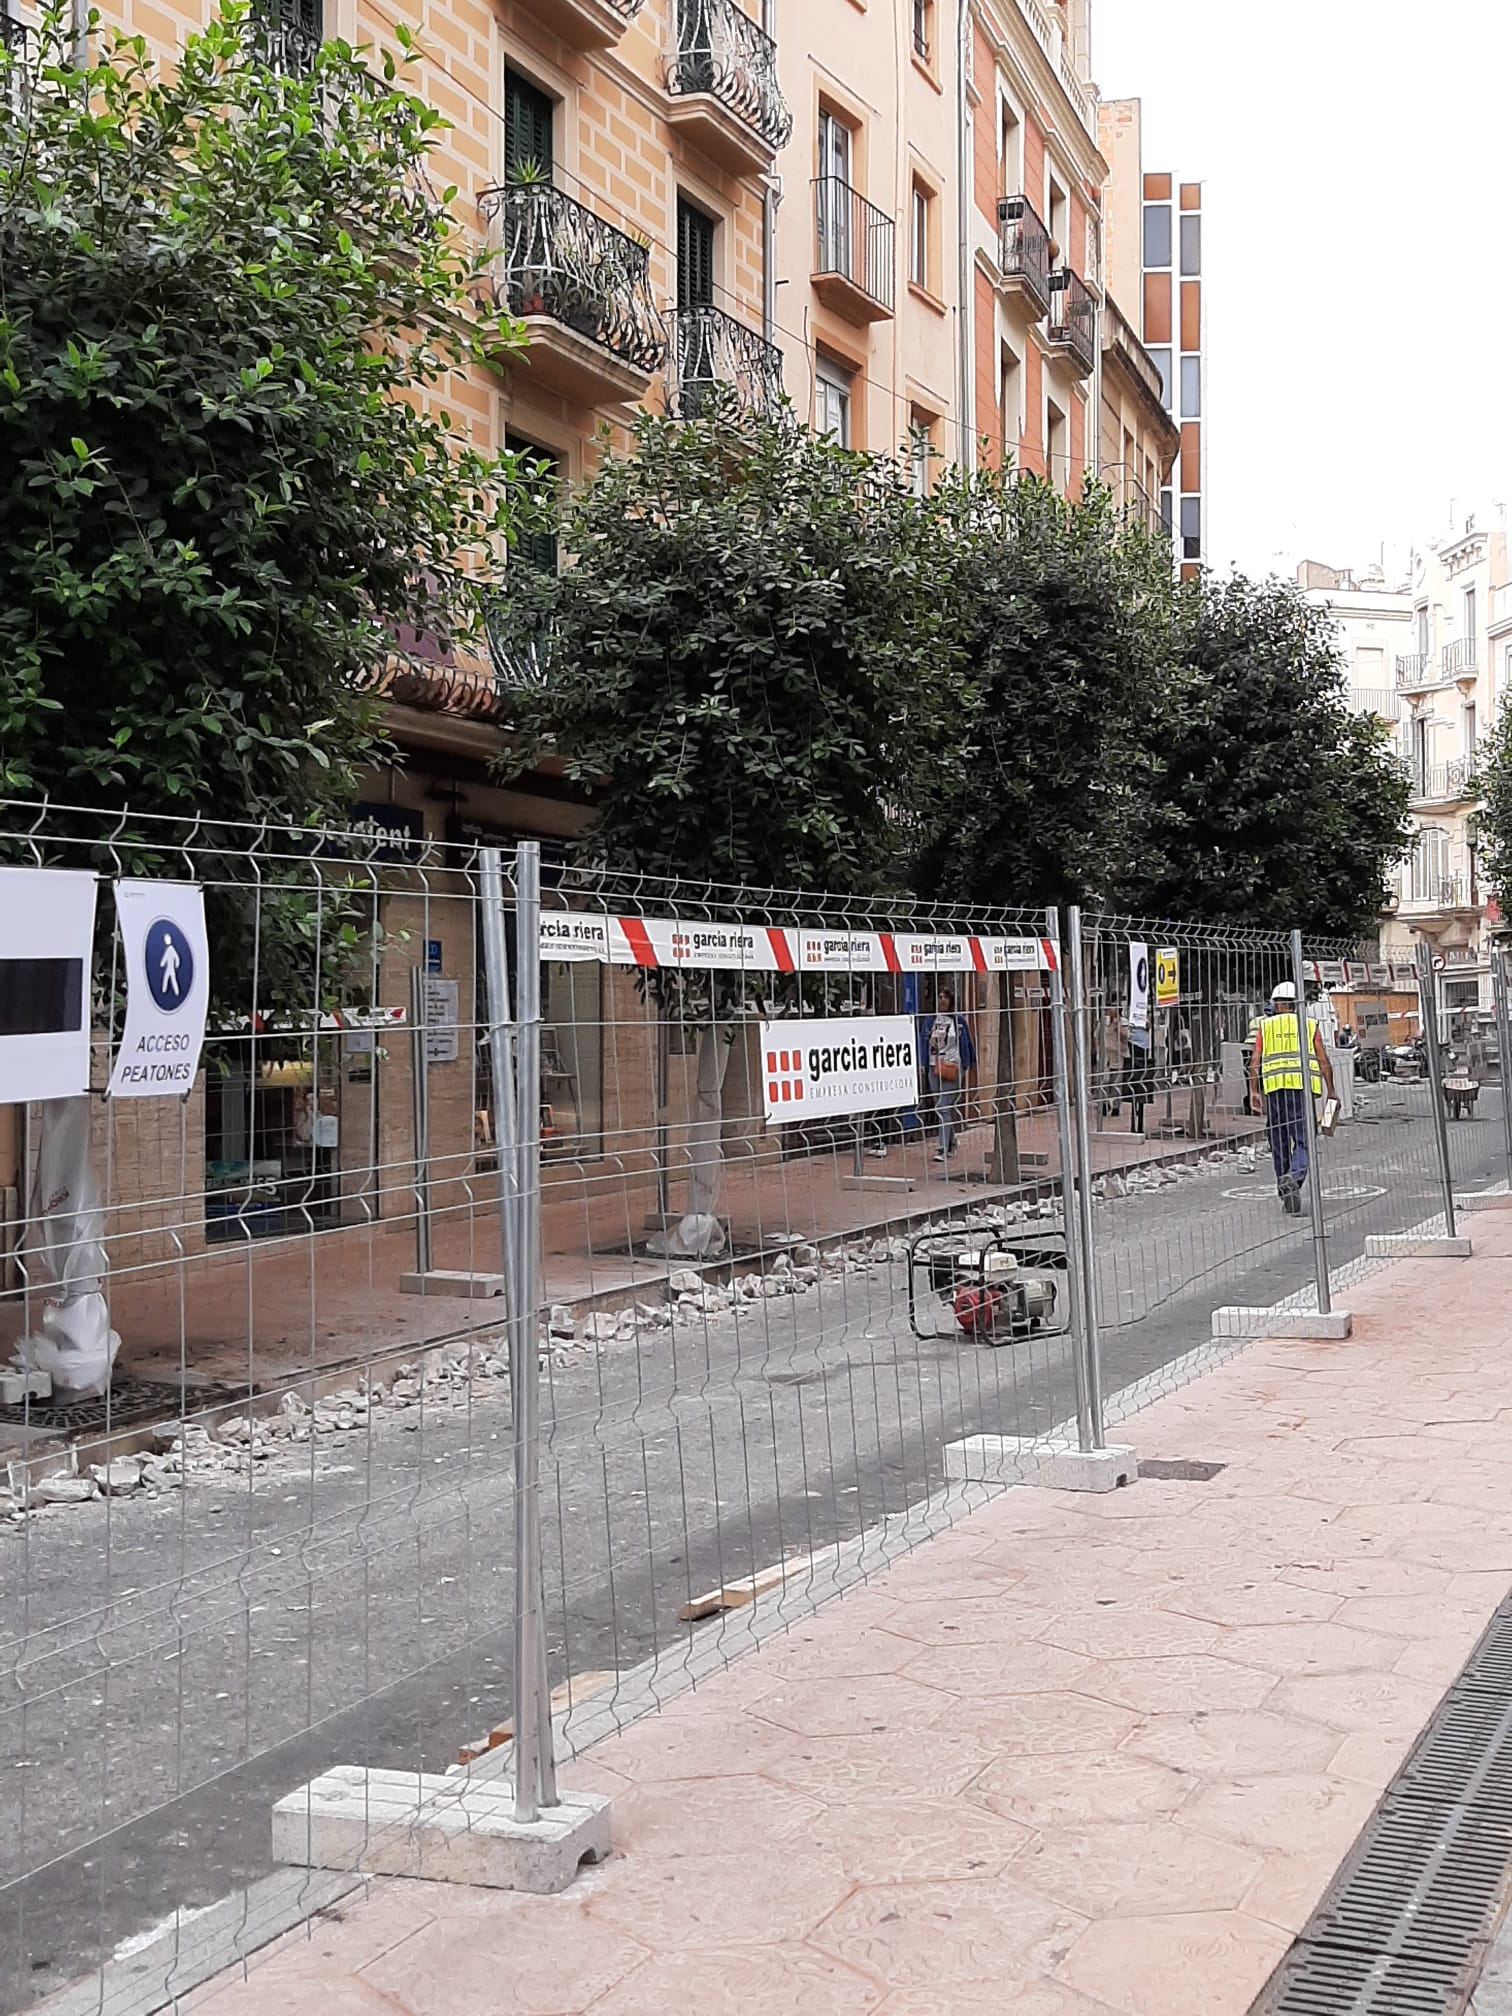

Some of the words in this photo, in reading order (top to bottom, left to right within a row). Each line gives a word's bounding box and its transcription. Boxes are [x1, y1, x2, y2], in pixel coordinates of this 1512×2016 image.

[540, 919, 570, 937] rcia
[574, 920, 604, 941] riera
[693, 930, 727, 950] garcia
[730, 931, 754, 949] riera
[135, 1033, 190, 1053] ACCESO
[808, 1037, 868, 1082] garcia
[872, 1036, 912, 1069] riera
[120, 1062, 192, 1083] PEATONES
[810, 1084, 848, 1099] EMPRESA
[852, 1077, 913, 1095] CONSTRUCTORA
